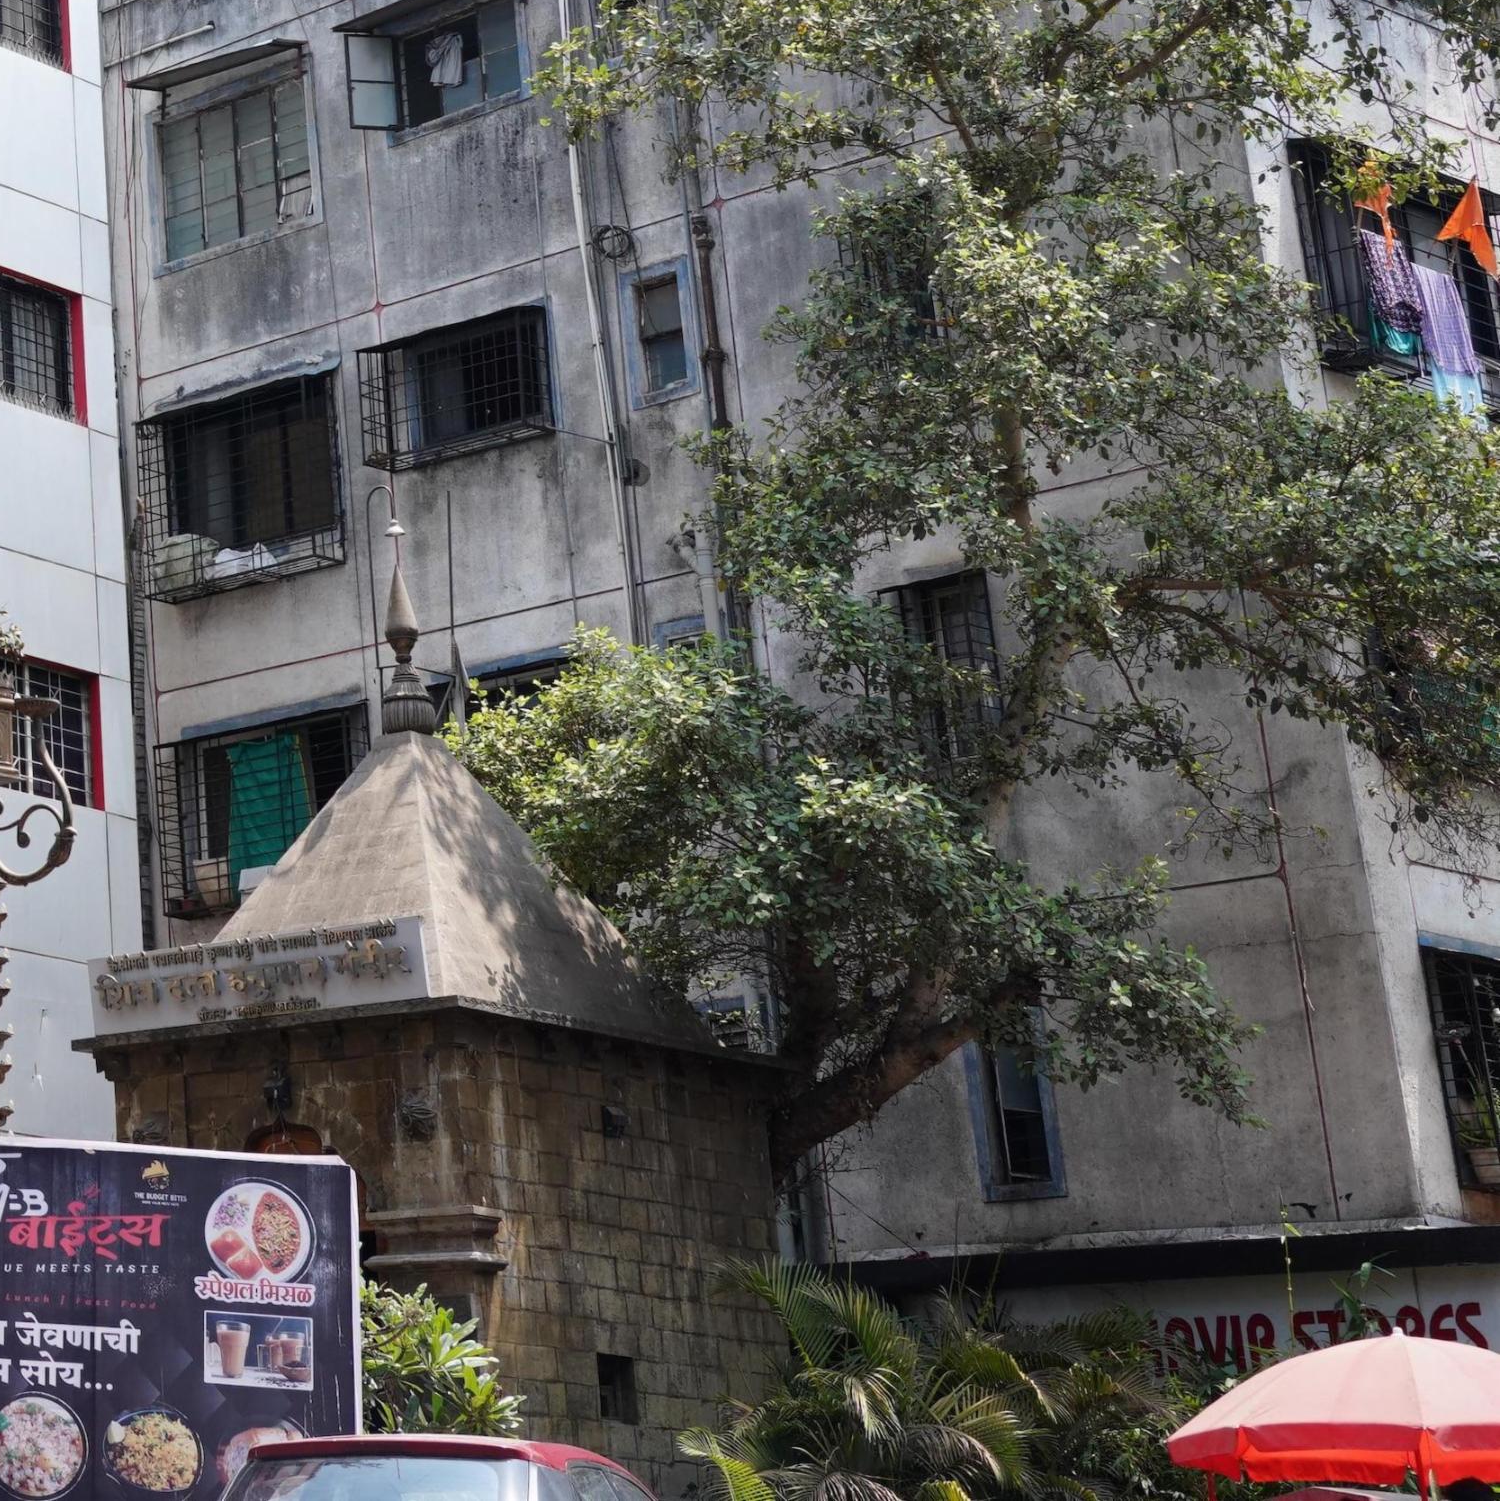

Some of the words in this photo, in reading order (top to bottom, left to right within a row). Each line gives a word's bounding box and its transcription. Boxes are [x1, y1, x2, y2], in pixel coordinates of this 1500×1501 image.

[134, 1191, 145, 1200] THE
[146, 1192, 169, 1201] BUDGET
[6, 1200, 171, 1261] बाईट्स
[35, 1262, 93, 1274] MEETS
[104, 1262, 161, 1275] TASTE
[4, 1292, 50, 1304] Lunch
[75, 1296, 110, 1307] Fast
[120, 1299, 158, 1310] Food
[198, 1273, 251, 1300] स्पेशल
[259, 1278, 314, 1305] मिसळ
[14, 1311, 141, 1355] जेवणाची
[19, 1350, 115, 1392] सोय...
